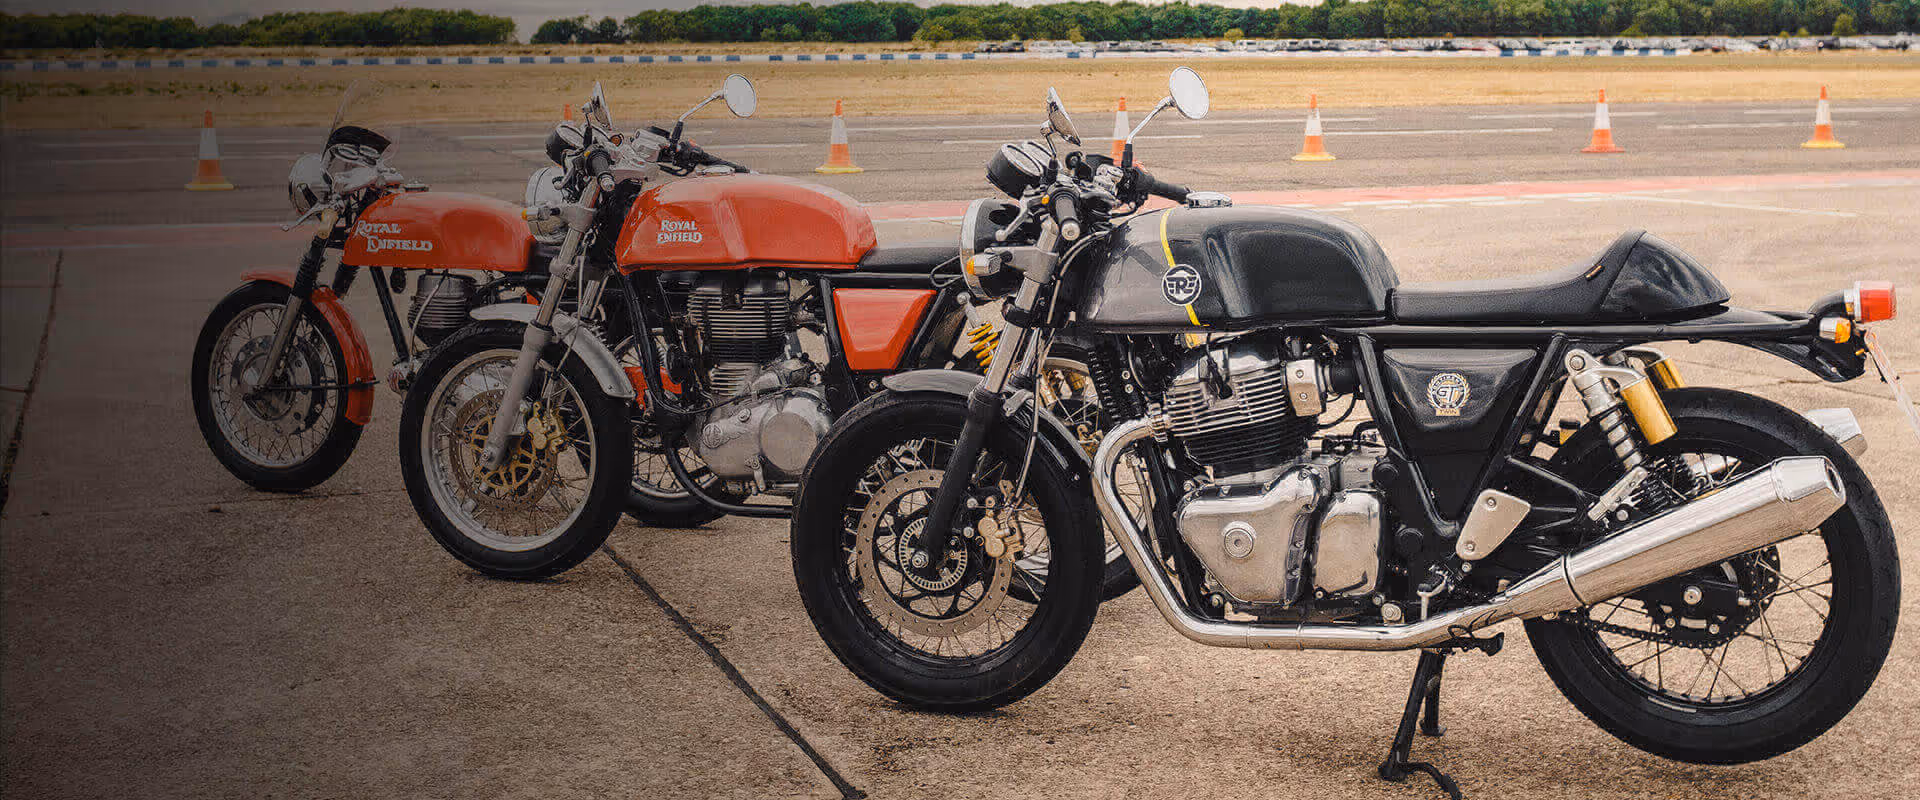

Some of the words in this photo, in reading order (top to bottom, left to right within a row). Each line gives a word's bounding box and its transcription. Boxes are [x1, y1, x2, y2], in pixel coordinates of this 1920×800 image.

[353, 220, 401, 238] ROYAL
[661, 219, 698, 231] ROYAL
[366, 235, 433, 252] ENFIELD
[657, 231, 703, 244] ENFIELD
